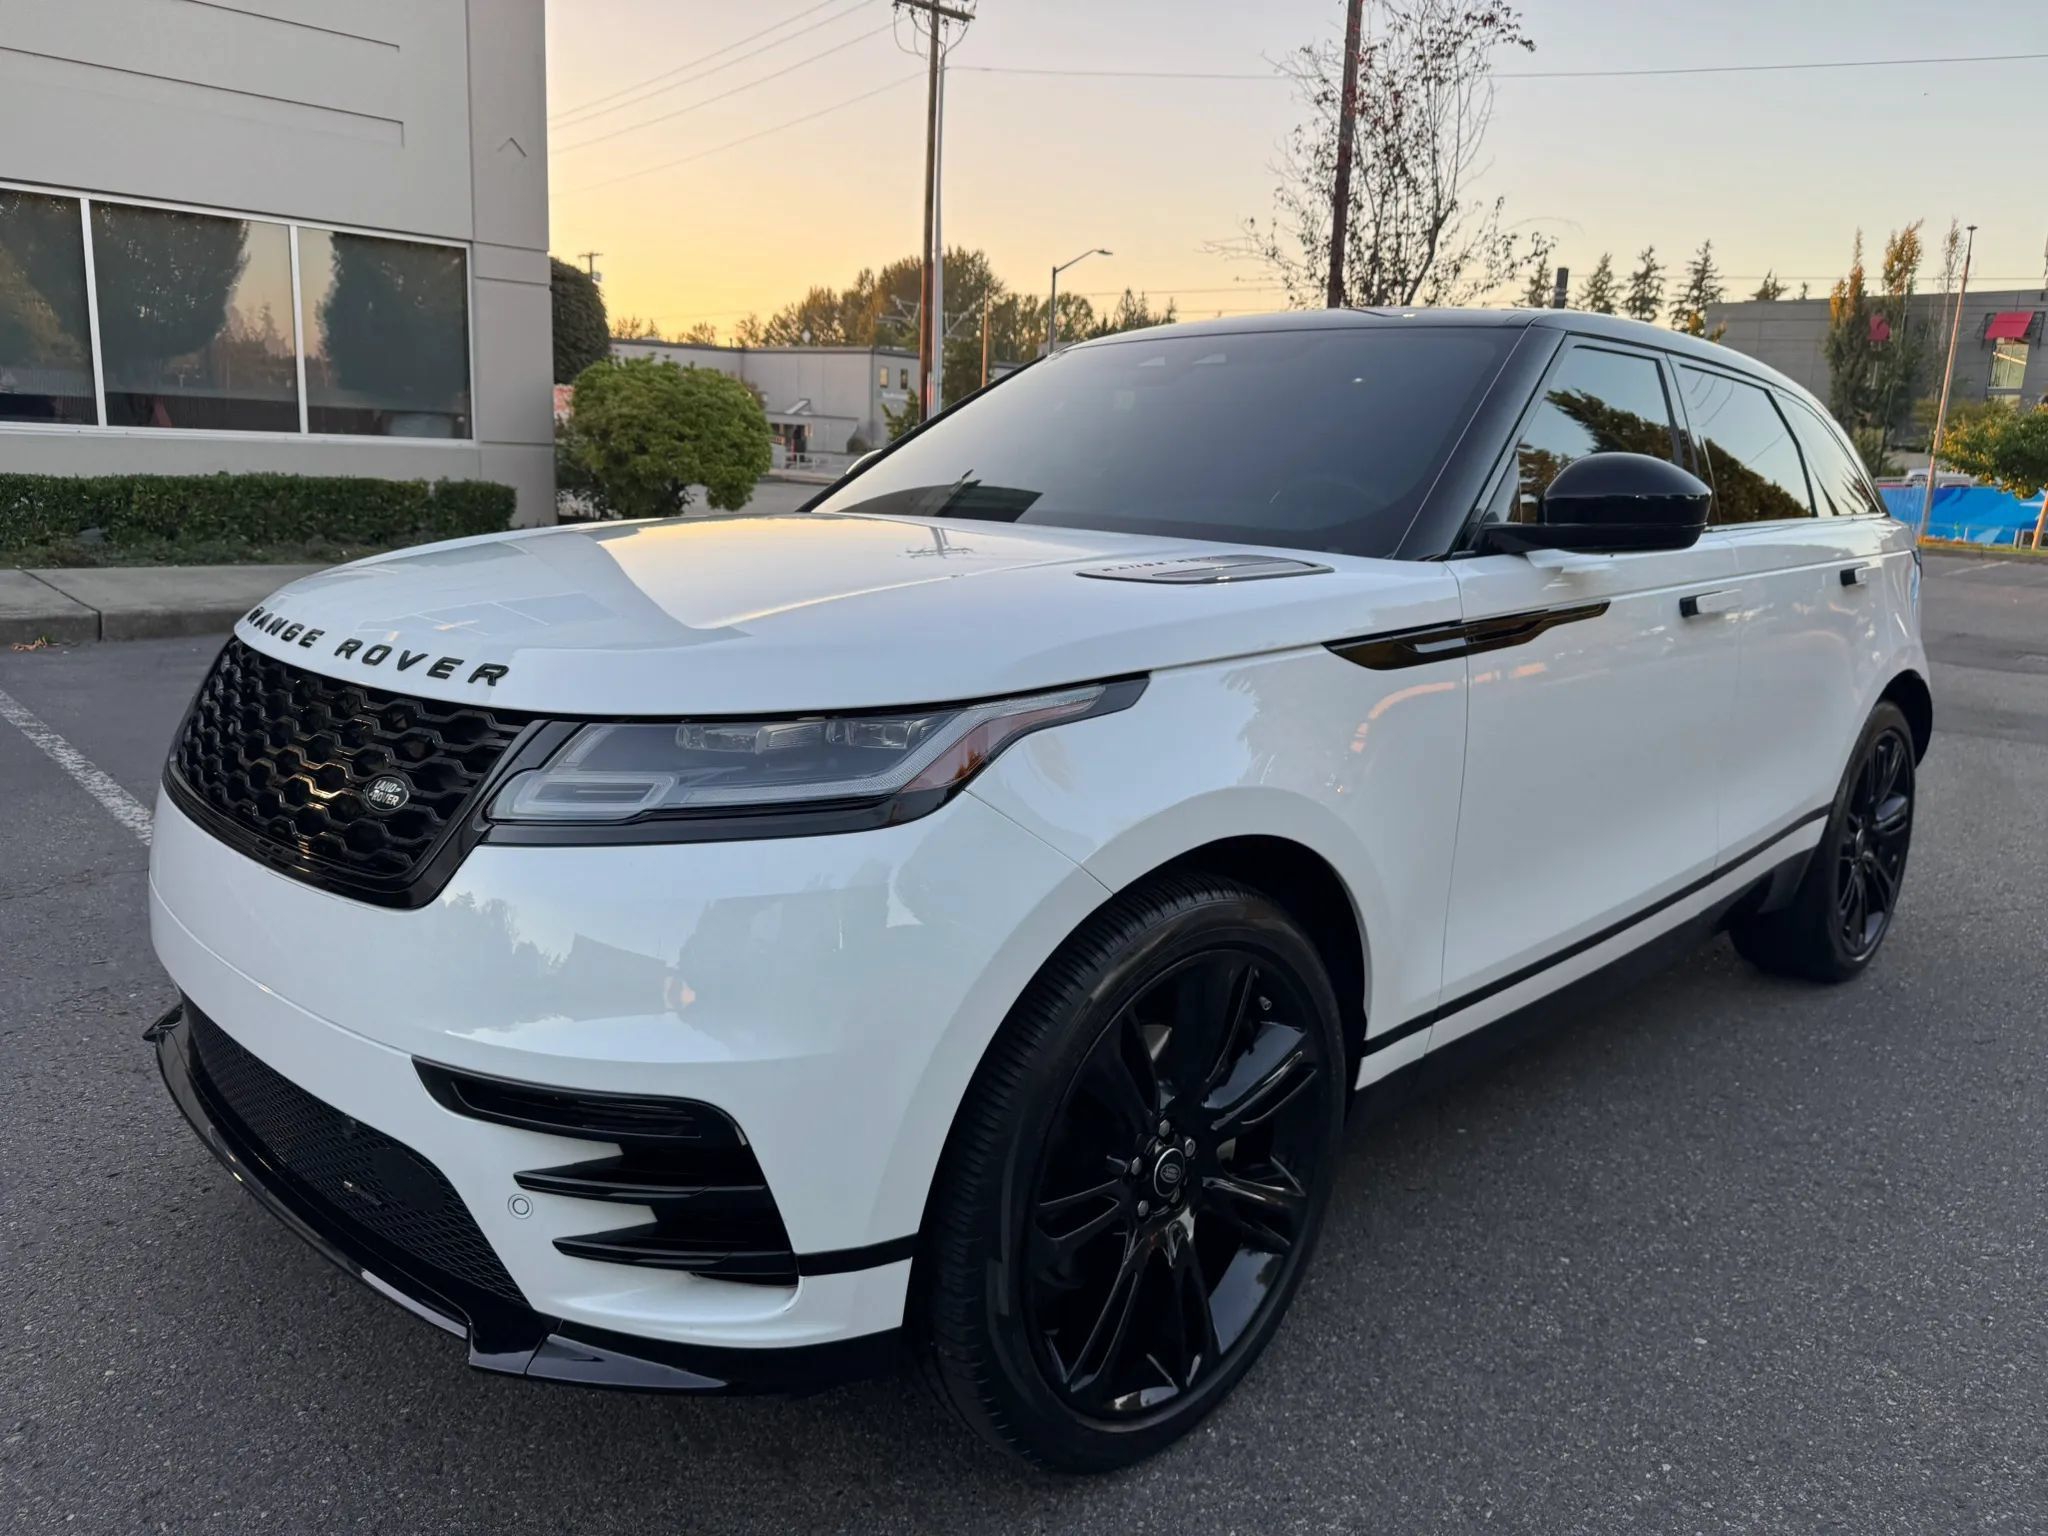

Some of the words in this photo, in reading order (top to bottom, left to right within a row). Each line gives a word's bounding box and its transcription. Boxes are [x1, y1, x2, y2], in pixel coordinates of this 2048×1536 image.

[247, 606, 325, 648] RANGE
[334, 638, 509, 686] ROVER
[374, 780, 398, 793] LAND
[371, 791, 400, 806] ROVER
